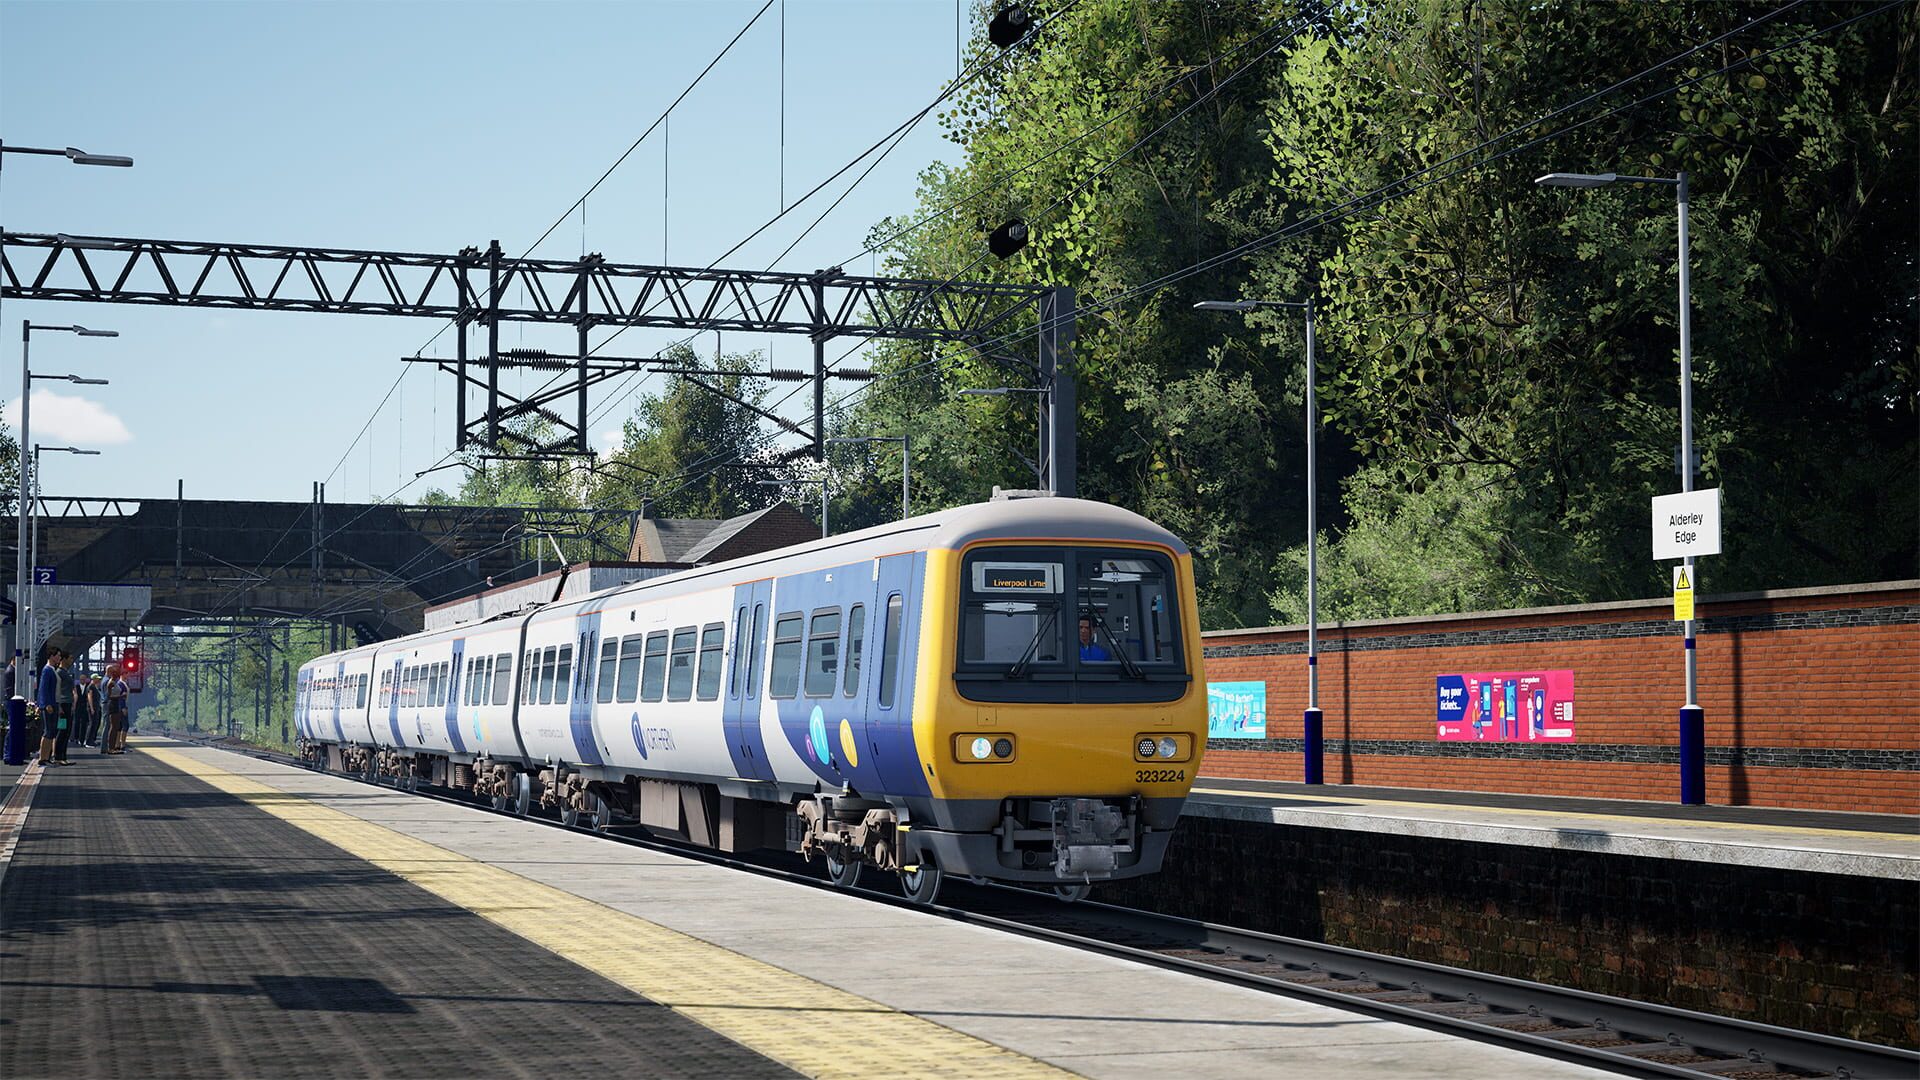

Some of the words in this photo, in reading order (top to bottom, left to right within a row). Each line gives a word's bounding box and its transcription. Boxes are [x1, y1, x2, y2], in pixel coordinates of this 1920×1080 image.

[1669, 512, 1703, 526] Alderley
[1675, 531, 1696, 544] Edge
[40, 572, 50, 583] 2
[993, 579, 1026, 588] Liverpool
[1440, 686, 1450, 699] Buy
[1450, 688, 1463, 699] your
[1135, 769, 1185, 783] 323224
